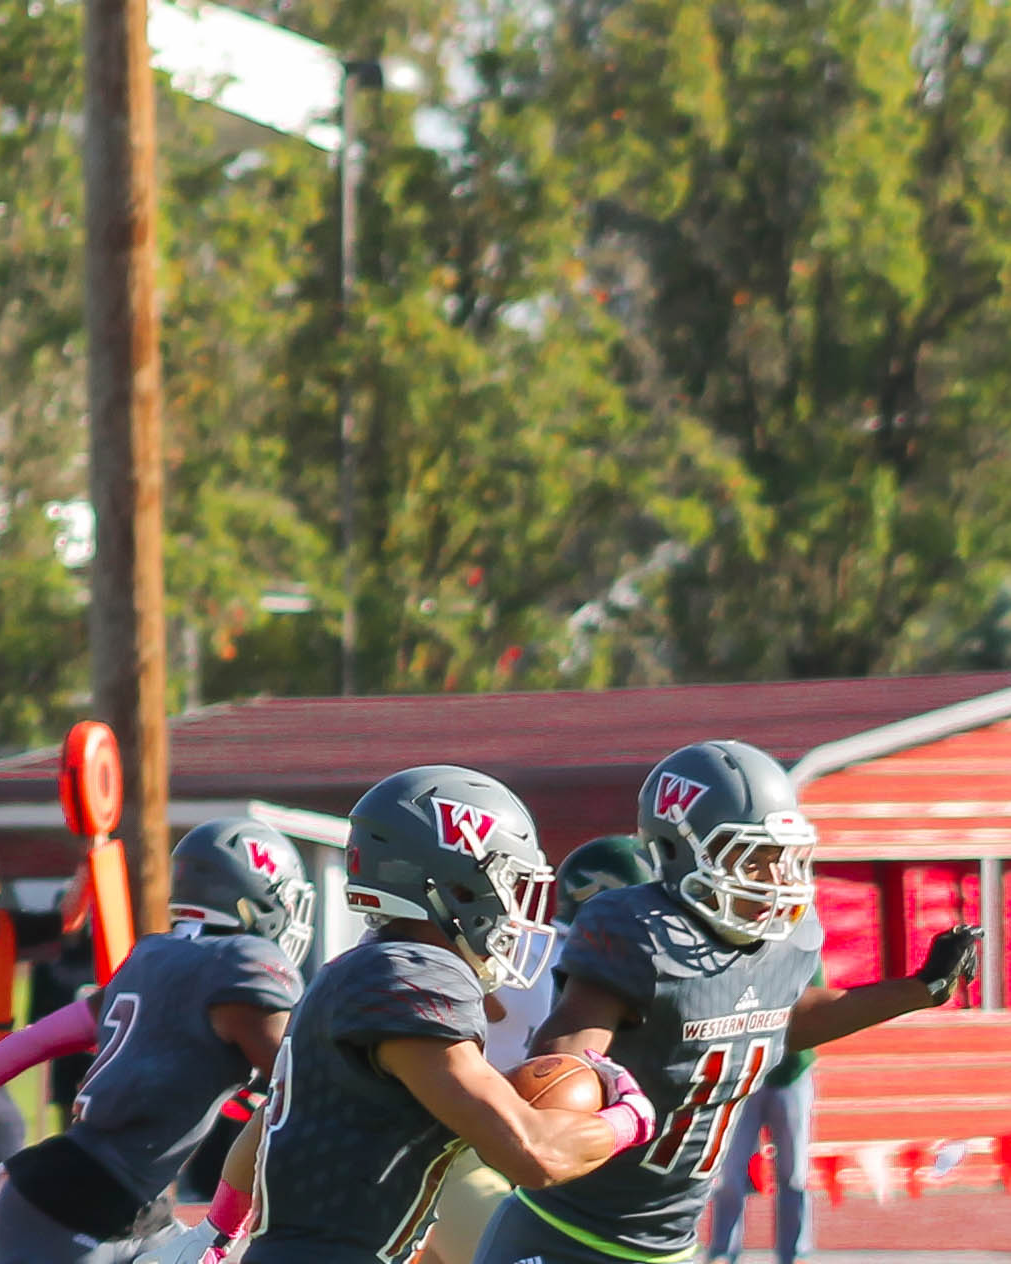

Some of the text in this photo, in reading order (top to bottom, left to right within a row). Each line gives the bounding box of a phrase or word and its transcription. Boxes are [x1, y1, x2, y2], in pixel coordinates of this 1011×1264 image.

[654, 771, 710, 824] W
[430, 797, 498, 856] W
[683, 1013, 748, 1041] WESTERN
[638, 1038, 771, 1179] 11
